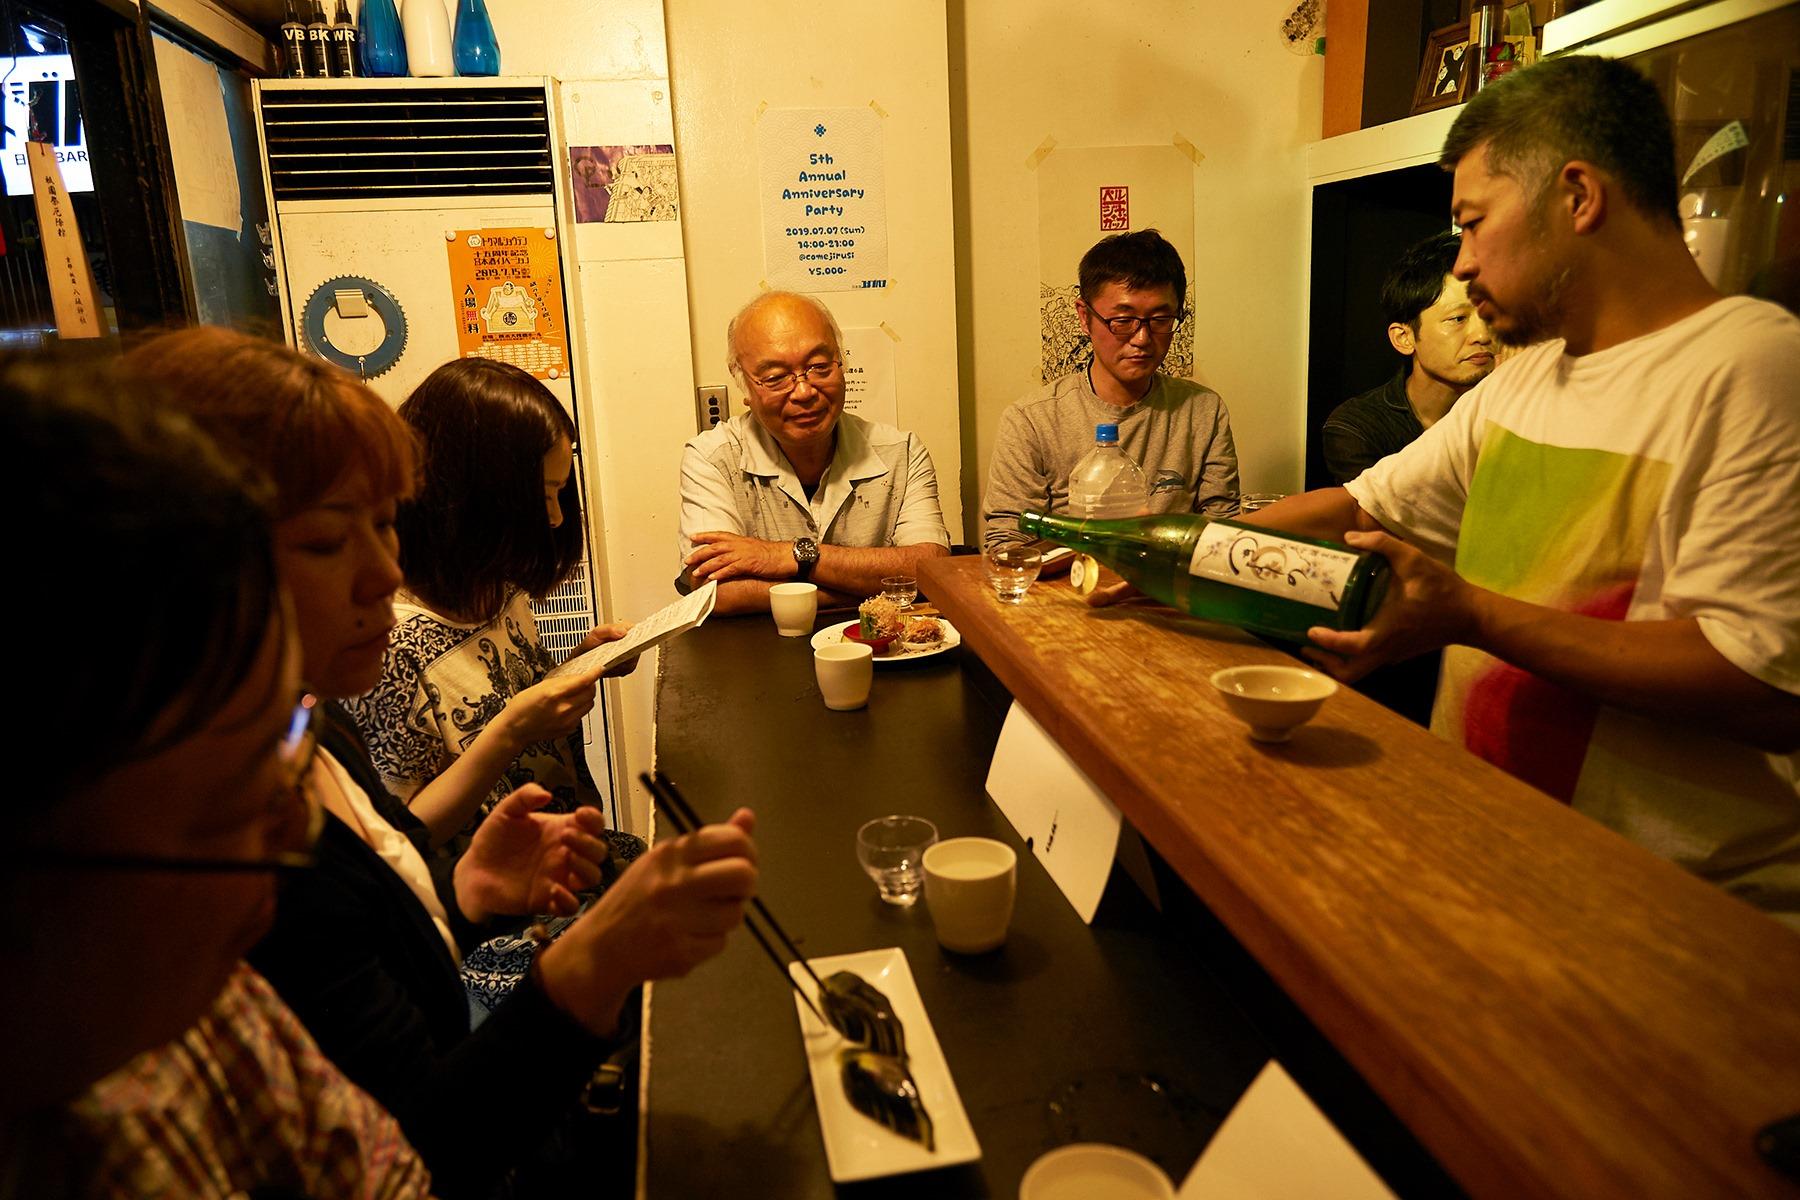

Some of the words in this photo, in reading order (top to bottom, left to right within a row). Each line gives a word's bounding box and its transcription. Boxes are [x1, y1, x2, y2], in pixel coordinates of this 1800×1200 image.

[284, 29, 305, 41] VB
[309, 29, 330, 42] BK
[333, 29, 355, 42] WR
[56, 150, 88, 163] BAR
[809, 153, 833, 165] 5th
[798, 170, 846, 182] Annual
[782, 188, 865, 200] Anniversary
[805, 204, 843, 217] Party
[785, 226, 838, 236] 2019.07.07
[797, 239, 855, 249] 14:00-21:00
[798, 251, 855, 261] @comejirusi
[464, 284, 479, 334] 入場無料
